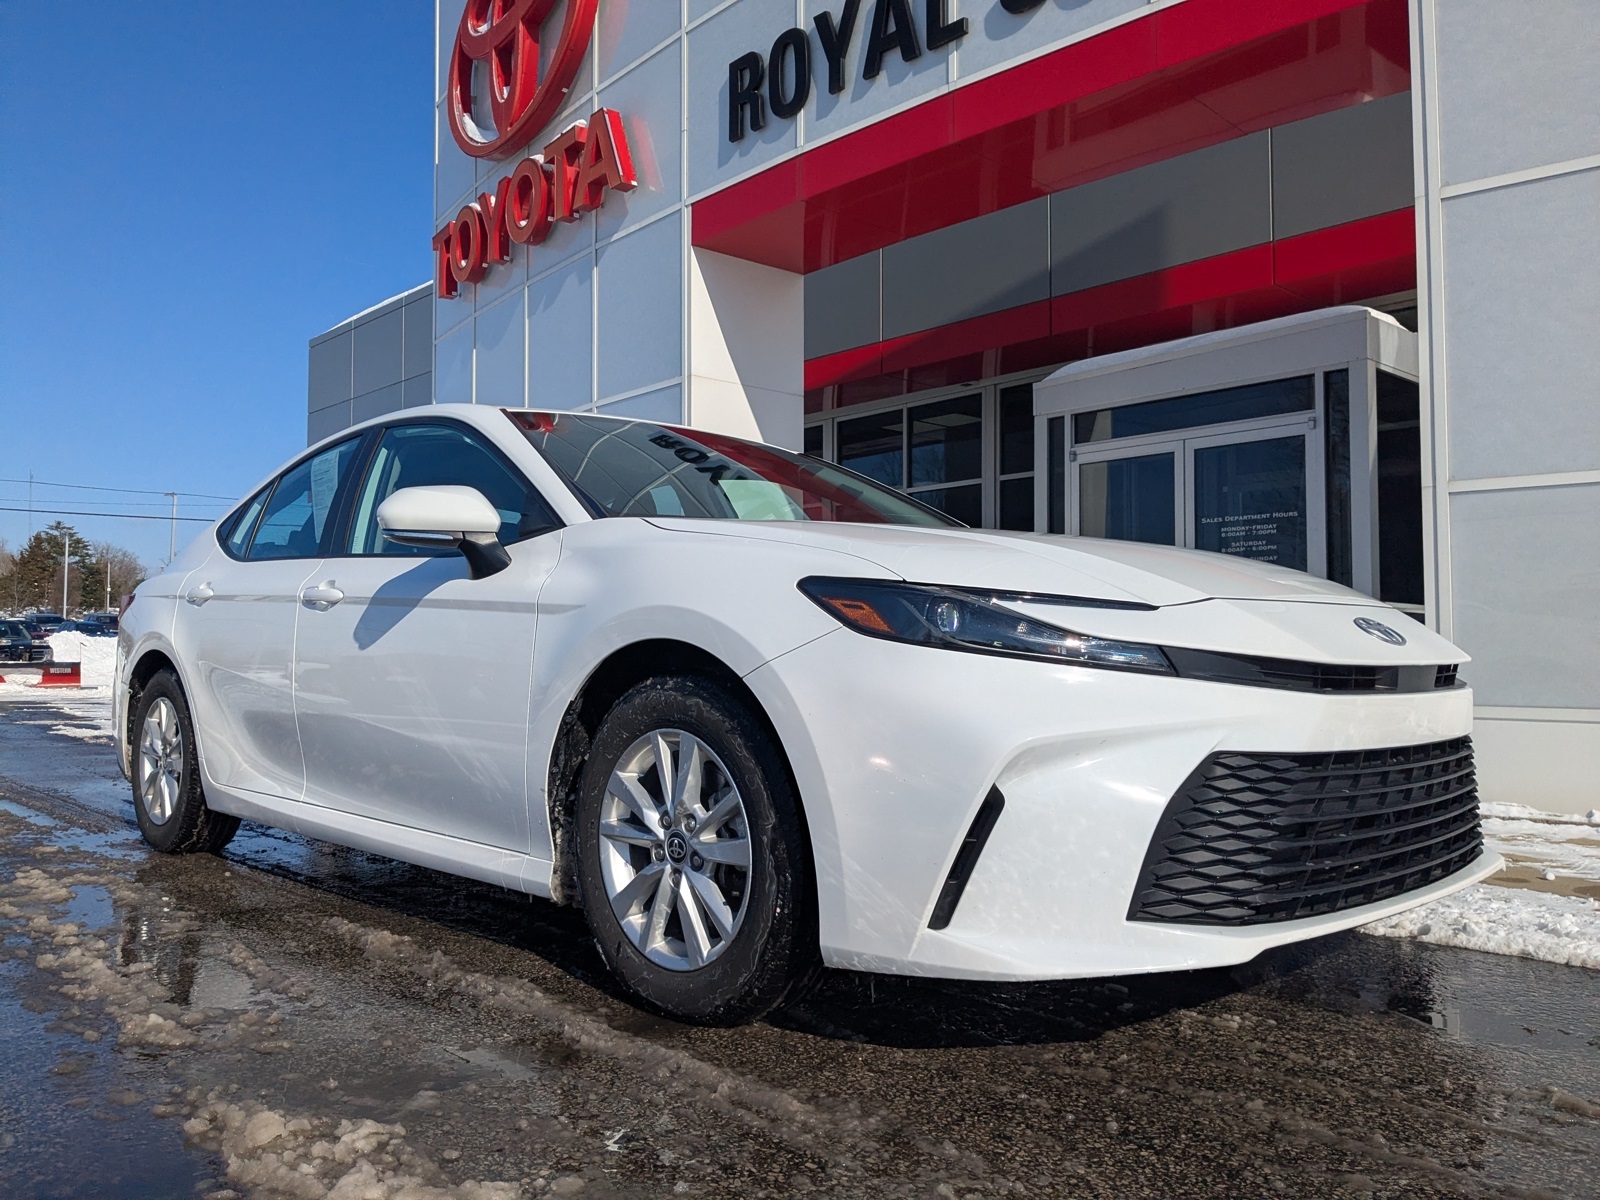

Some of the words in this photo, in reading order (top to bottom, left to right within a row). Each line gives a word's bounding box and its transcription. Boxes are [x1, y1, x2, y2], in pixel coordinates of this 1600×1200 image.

[728, 0, 968, 143] ROYAL
[432, 107, 638, 300] TOYOTA
[1224, 514, 1271, 522] DEPARTMENT
[1221, 524, 1278, 532] MONDAY-FRIDAY
[1231, 540, 1267, 548] SATURDAY
